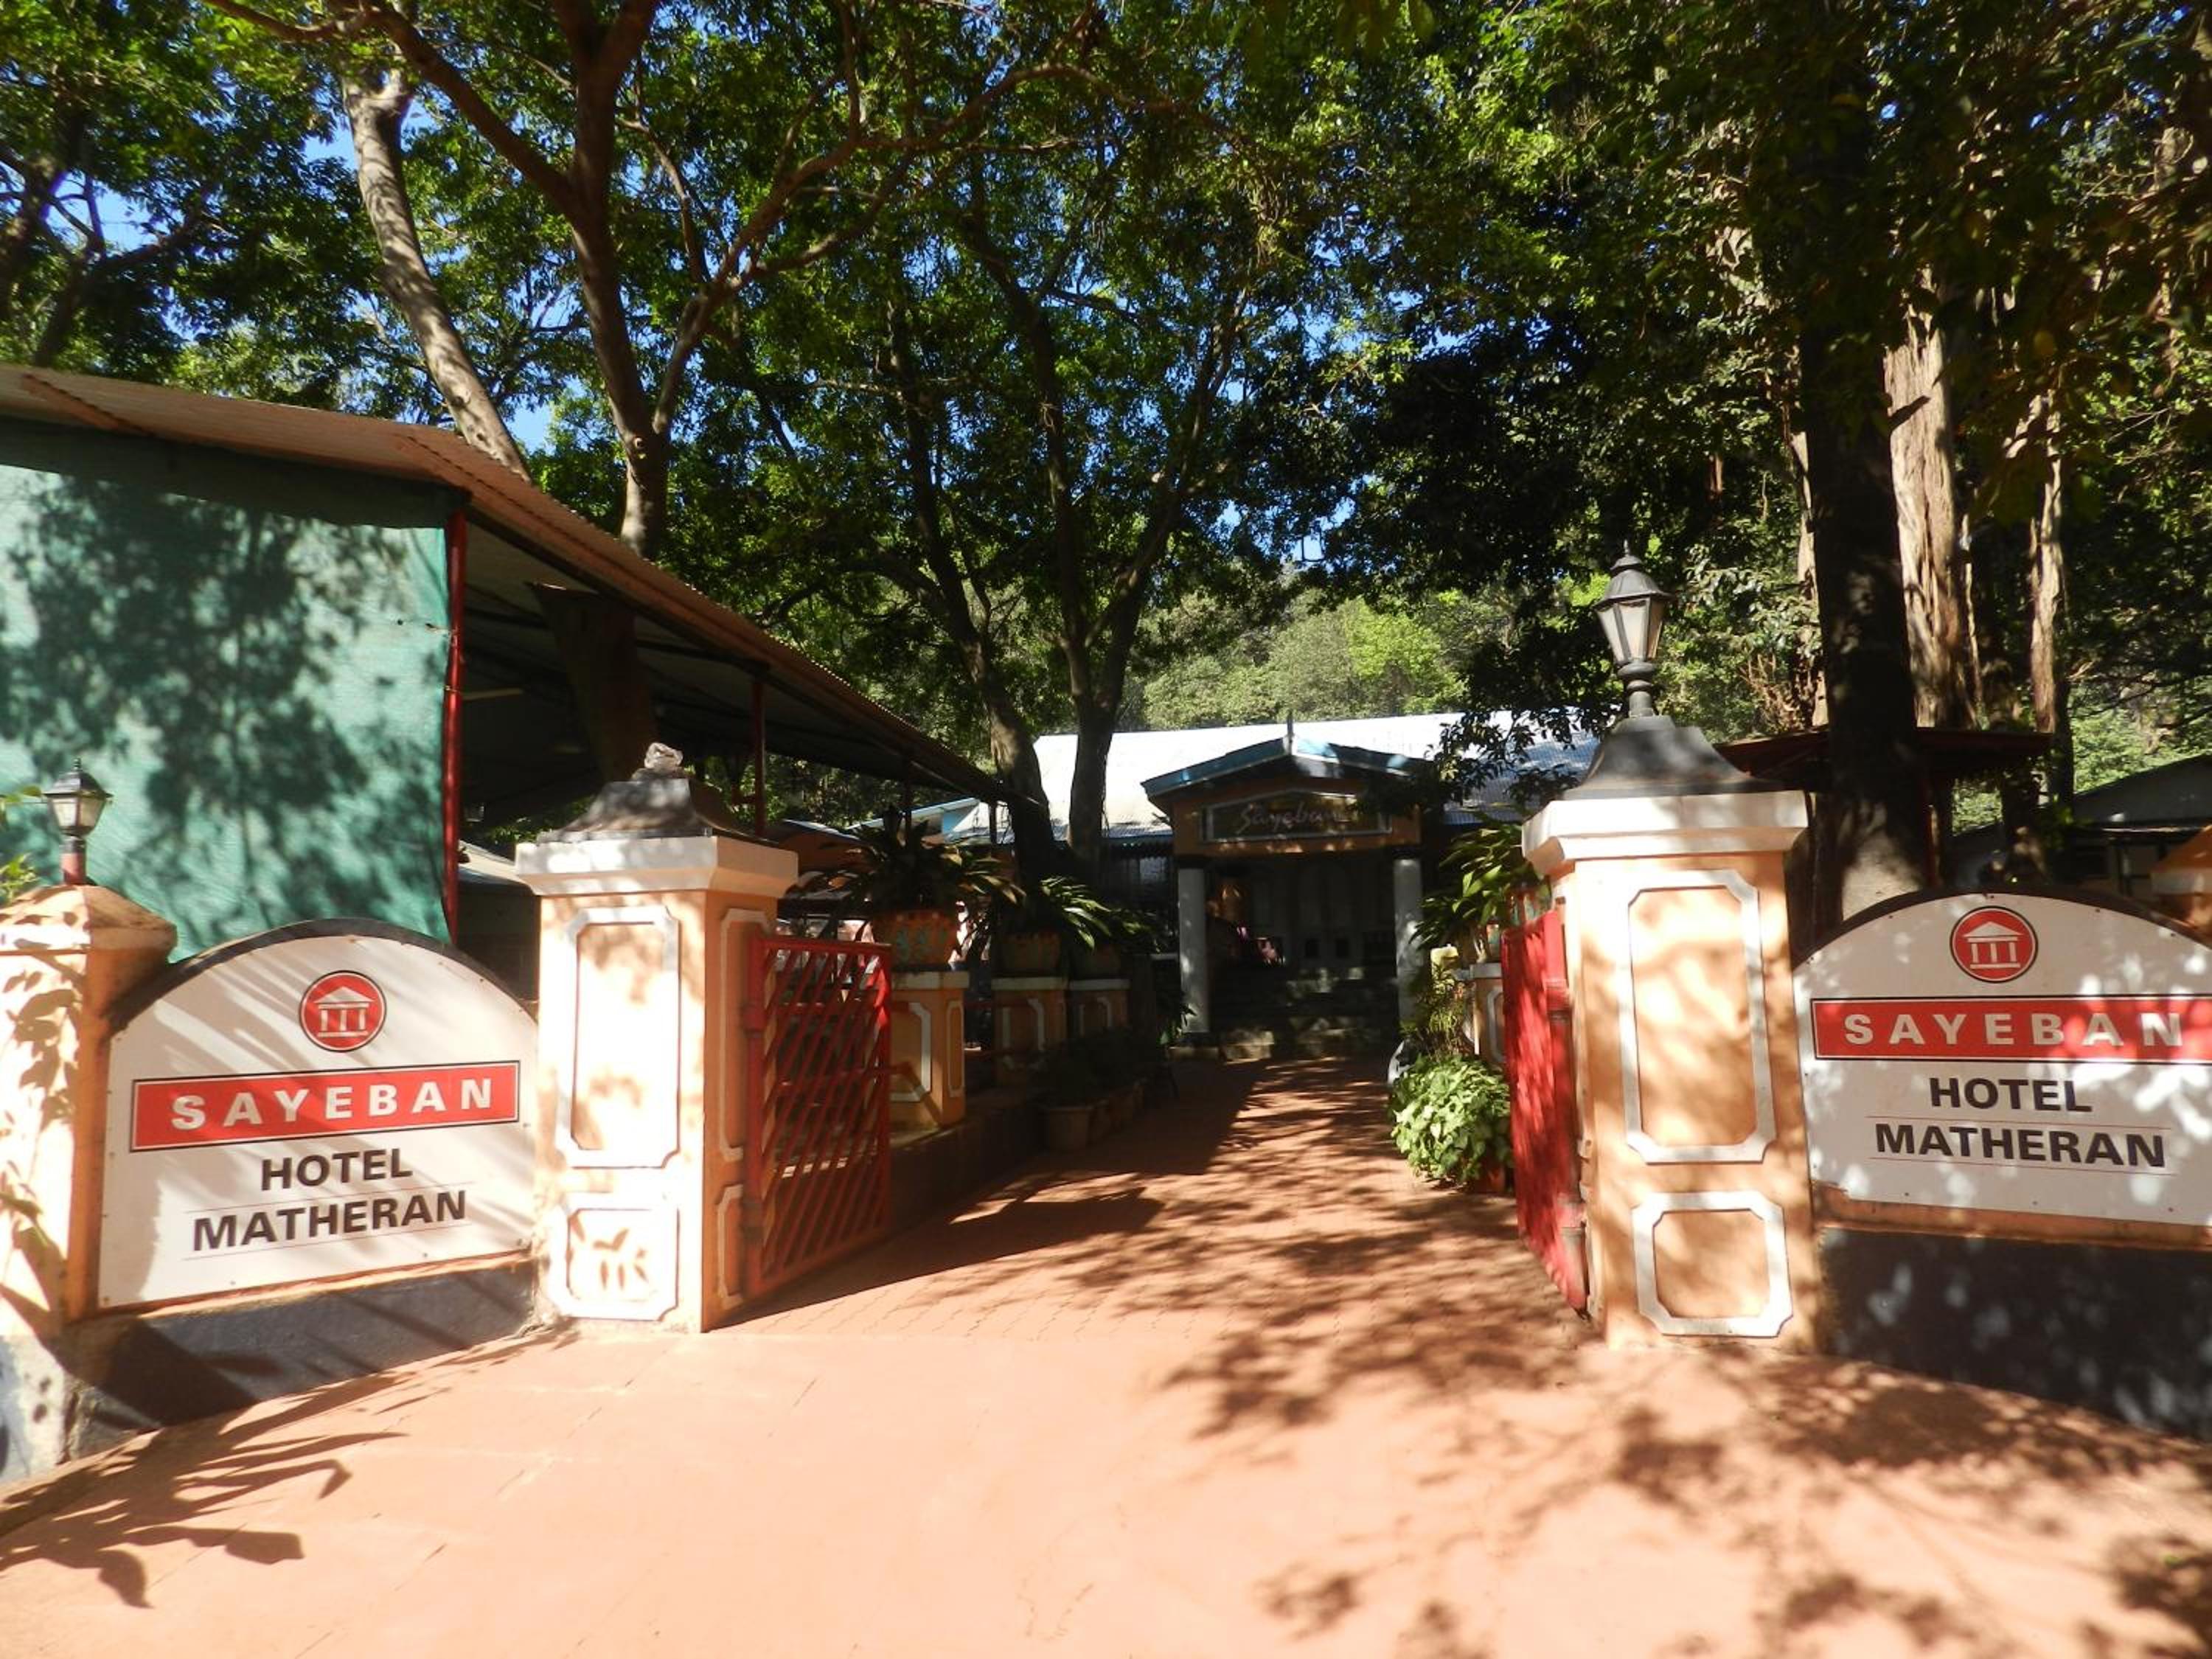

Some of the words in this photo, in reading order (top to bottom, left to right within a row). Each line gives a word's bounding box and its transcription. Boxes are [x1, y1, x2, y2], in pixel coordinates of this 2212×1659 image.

[1843, 1012, 2184, 1047] SAYEBAN
[170, 1078, 493, 1131] SAYEBAN
[1928, 1077, 2093, 1113] HOTEL
[1874, 1122, 2166, 1168] MATHERAN
[260, 1148, 414, 1192] HOTEL
[192, 1189, 467, 1252] MATHERAN
